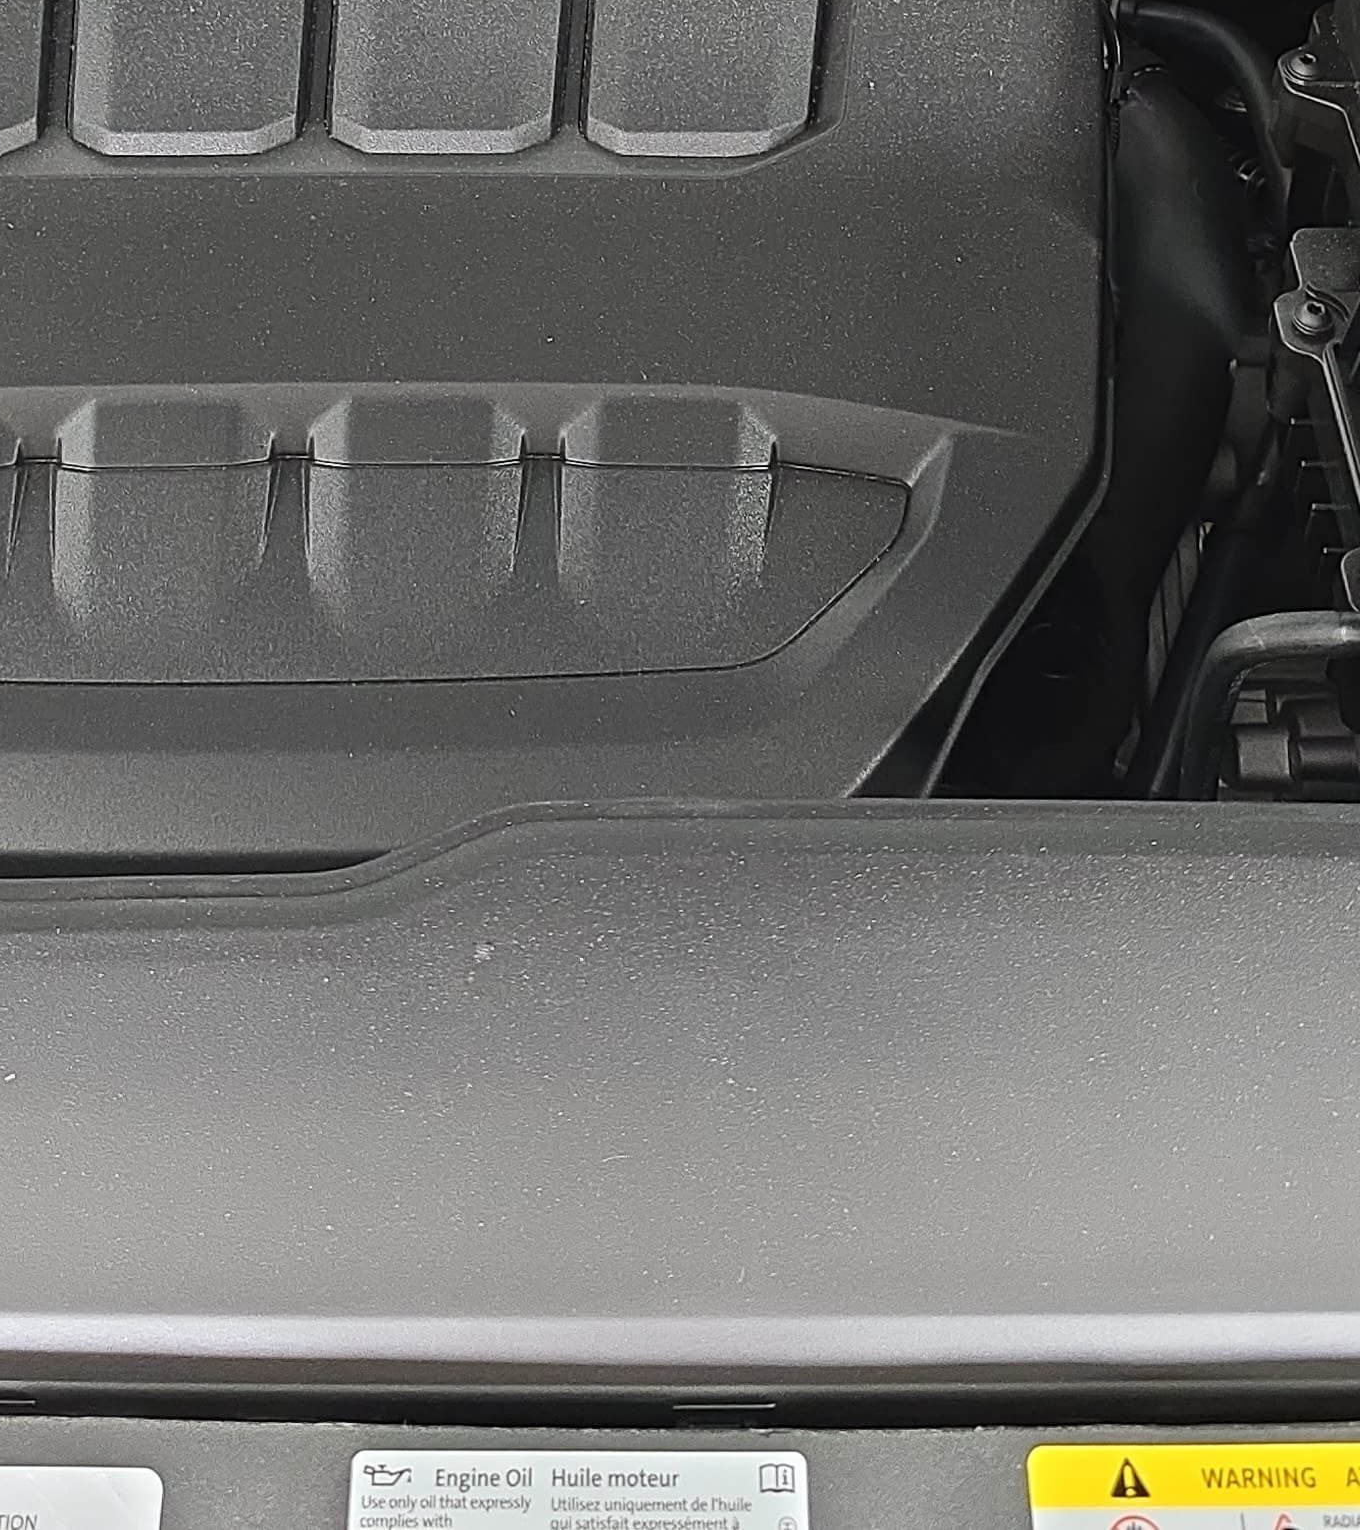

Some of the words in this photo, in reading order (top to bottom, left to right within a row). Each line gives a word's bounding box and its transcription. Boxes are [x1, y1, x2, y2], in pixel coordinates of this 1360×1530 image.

[435, 1468, 500, 1493] Engine
[506, 1468, 533, 1487] Oil
[551, 1468, 602, 1488] Huile
[608, 1469, 680, 1488] moteur
[1201, 1466, 1317, 1489] WARNING
[361, 1495, 384, 1510] Use
[390, 1494, 418, 1513] only
[420, 1494, 437, 1510] oil
[440, 1495, 467, 1510] that
[470, 1494, 532, 1514] expressly
[551, 1496, 601, 1512] Utilisez
[605, 1497, 688, 1517] uniquement
[691, 1496, 708, 1512] de
[711, 1496, 752, 1512] l'huile
[359, 1512, 419, 1530] complies
[423, 1512, 453, 1529] with
